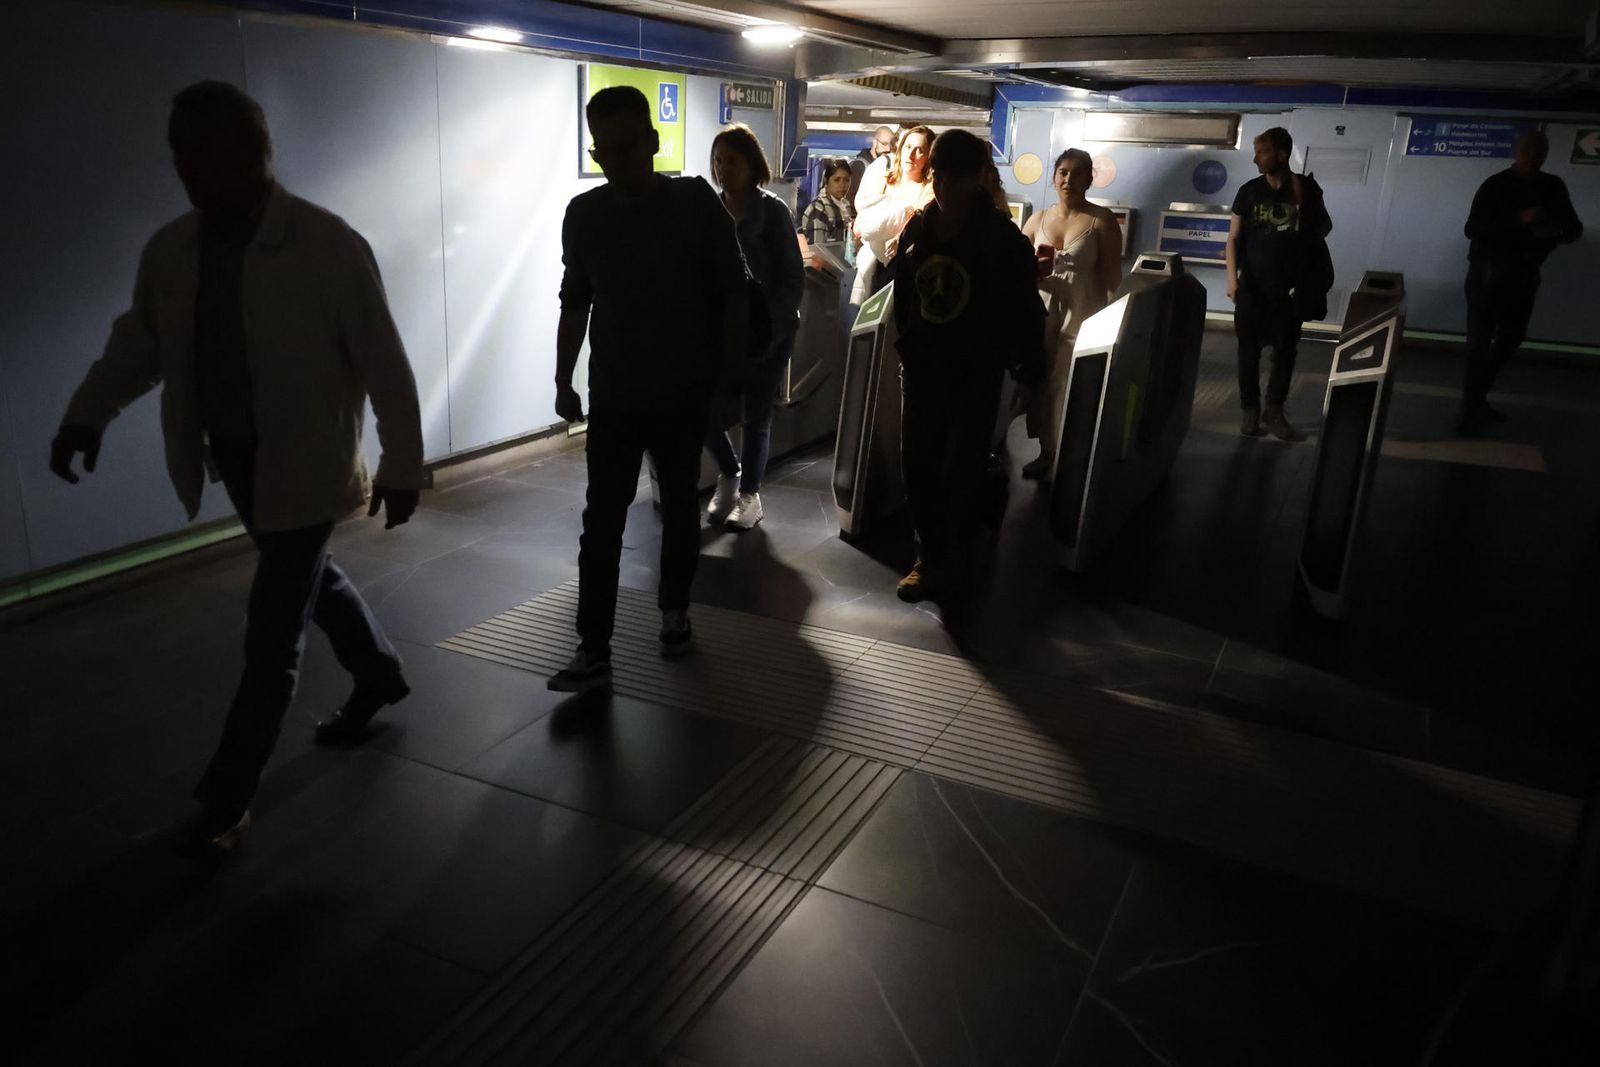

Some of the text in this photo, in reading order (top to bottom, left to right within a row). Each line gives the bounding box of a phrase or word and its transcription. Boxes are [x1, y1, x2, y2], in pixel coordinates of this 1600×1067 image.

[746, 88, 772, 105] SALIDA
[1433, 141, 1447, 153] 10
[1188, 230, 1210, 238] PAPEL
